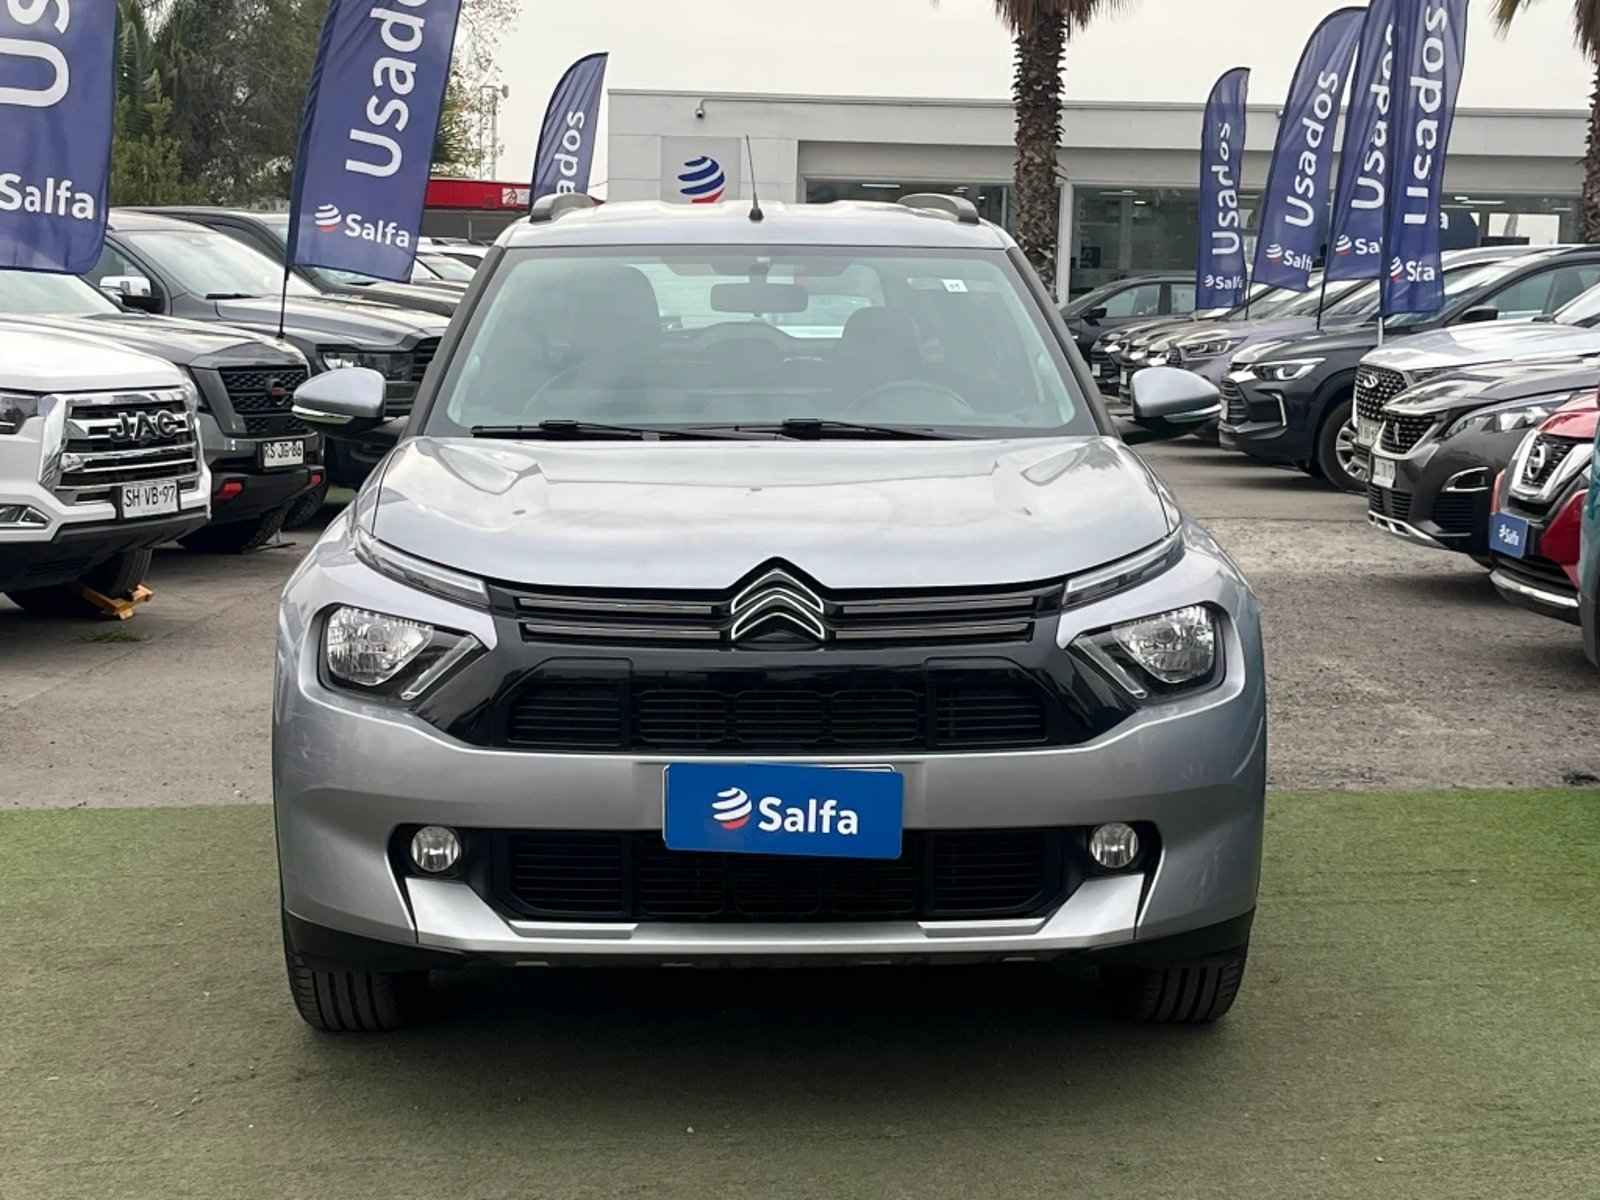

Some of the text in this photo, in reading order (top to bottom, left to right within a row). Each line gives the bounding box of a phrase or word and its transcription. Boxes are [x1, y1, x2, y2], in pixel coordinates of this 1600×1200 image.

[345, 0, 428, 177] Usad
[1285, 71, 1339, 228] Usados
[0, 173, 94, 220] Salfa
[344, 213, 410, 248] Salfa
[108, 410, 178, 442] JAC
[758, 796, 859, 835] Salfa
